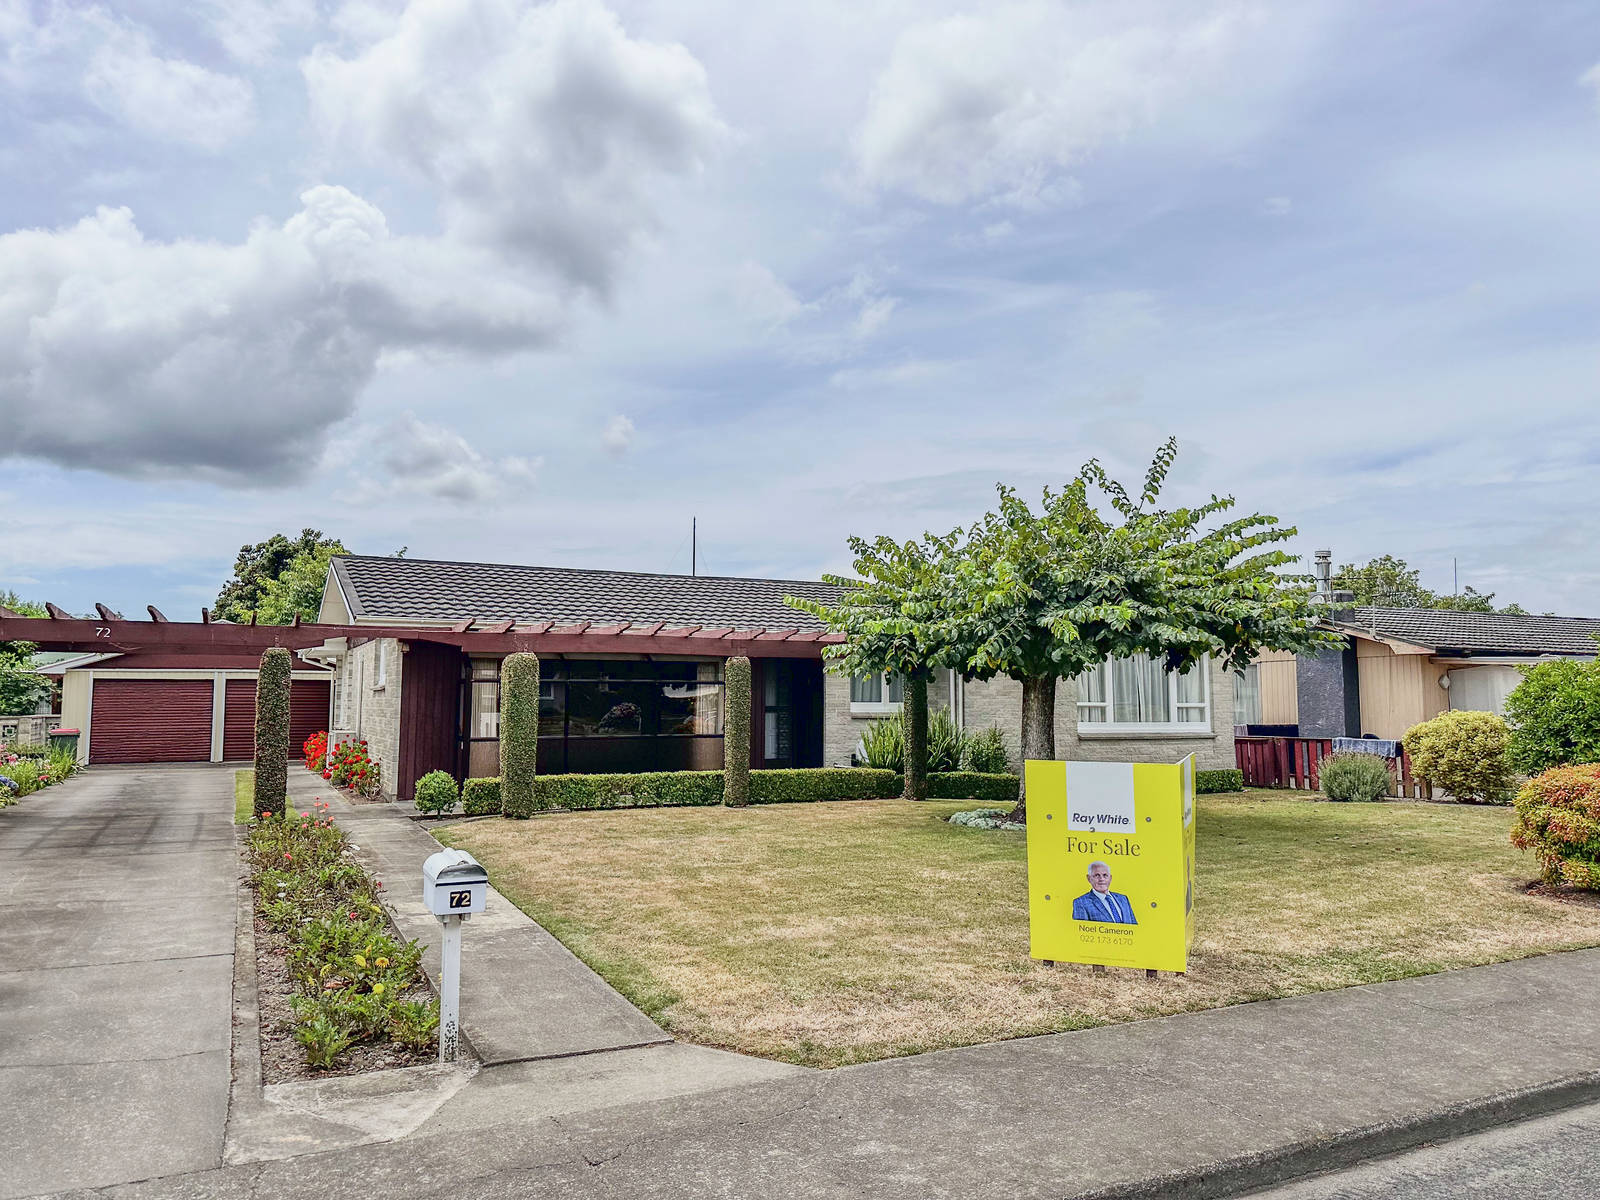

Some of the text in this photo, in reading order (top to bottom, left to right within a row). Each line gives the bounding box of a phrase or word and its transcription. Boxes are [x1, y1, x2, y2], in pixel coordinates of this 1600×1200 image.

[95, 627, 111, 638] 72
[1072, 812, 1095, 825] Ray
[1066, 836, 1141, 857] For Sale
[451, 892, 471, 906] 72
[1078, 924, 1134, 936] Noel Cameron
[1079, 934, 1134, 946] 022 173 6170
